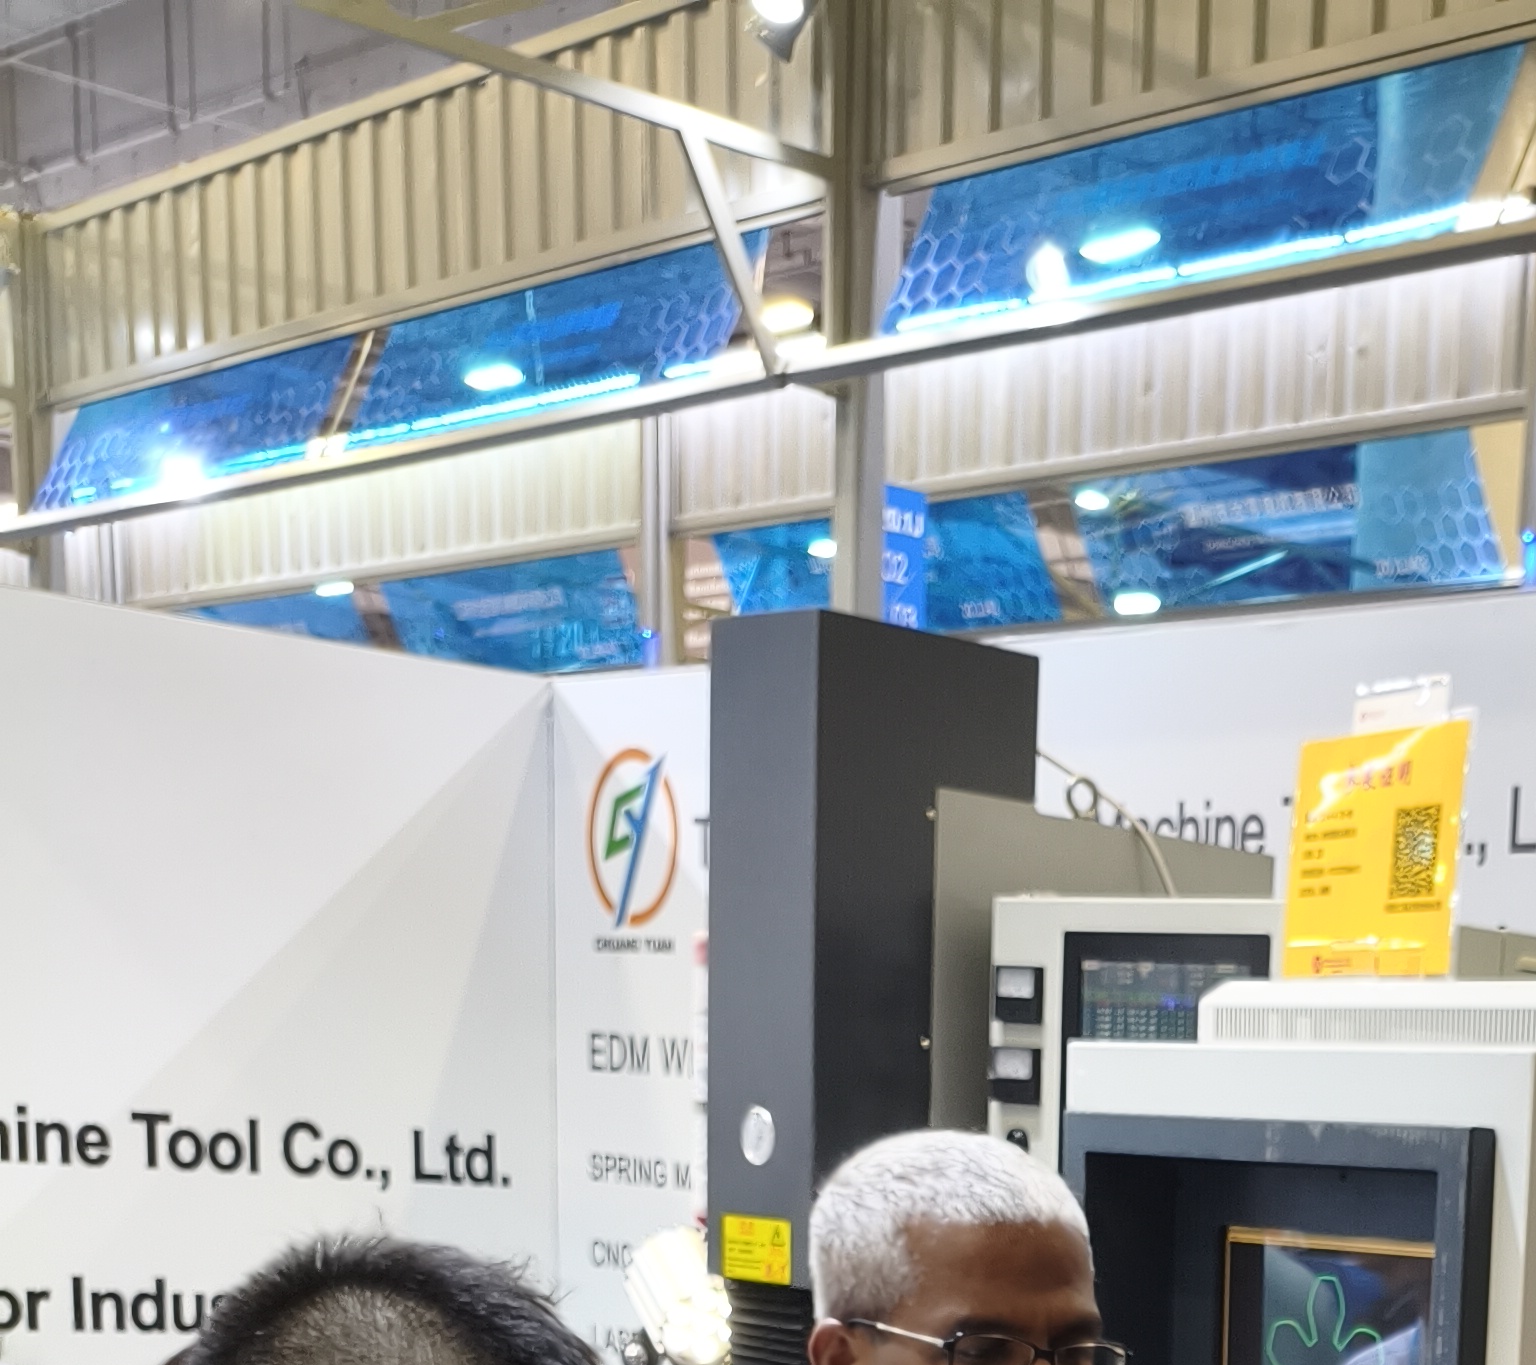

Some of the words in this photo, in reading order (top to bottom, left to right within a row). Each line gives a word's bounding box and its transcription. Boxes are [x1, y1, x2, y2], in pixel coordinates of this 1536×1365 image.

[590, 1032, 650, 1073] EDM
[130, 1111, 260, 1174] Tool
[282, 1120, 391, 1191] Co.,
[412, 1129, 511, 1187] Ltd.
[591, 1153, 667, 1188] SPRING
